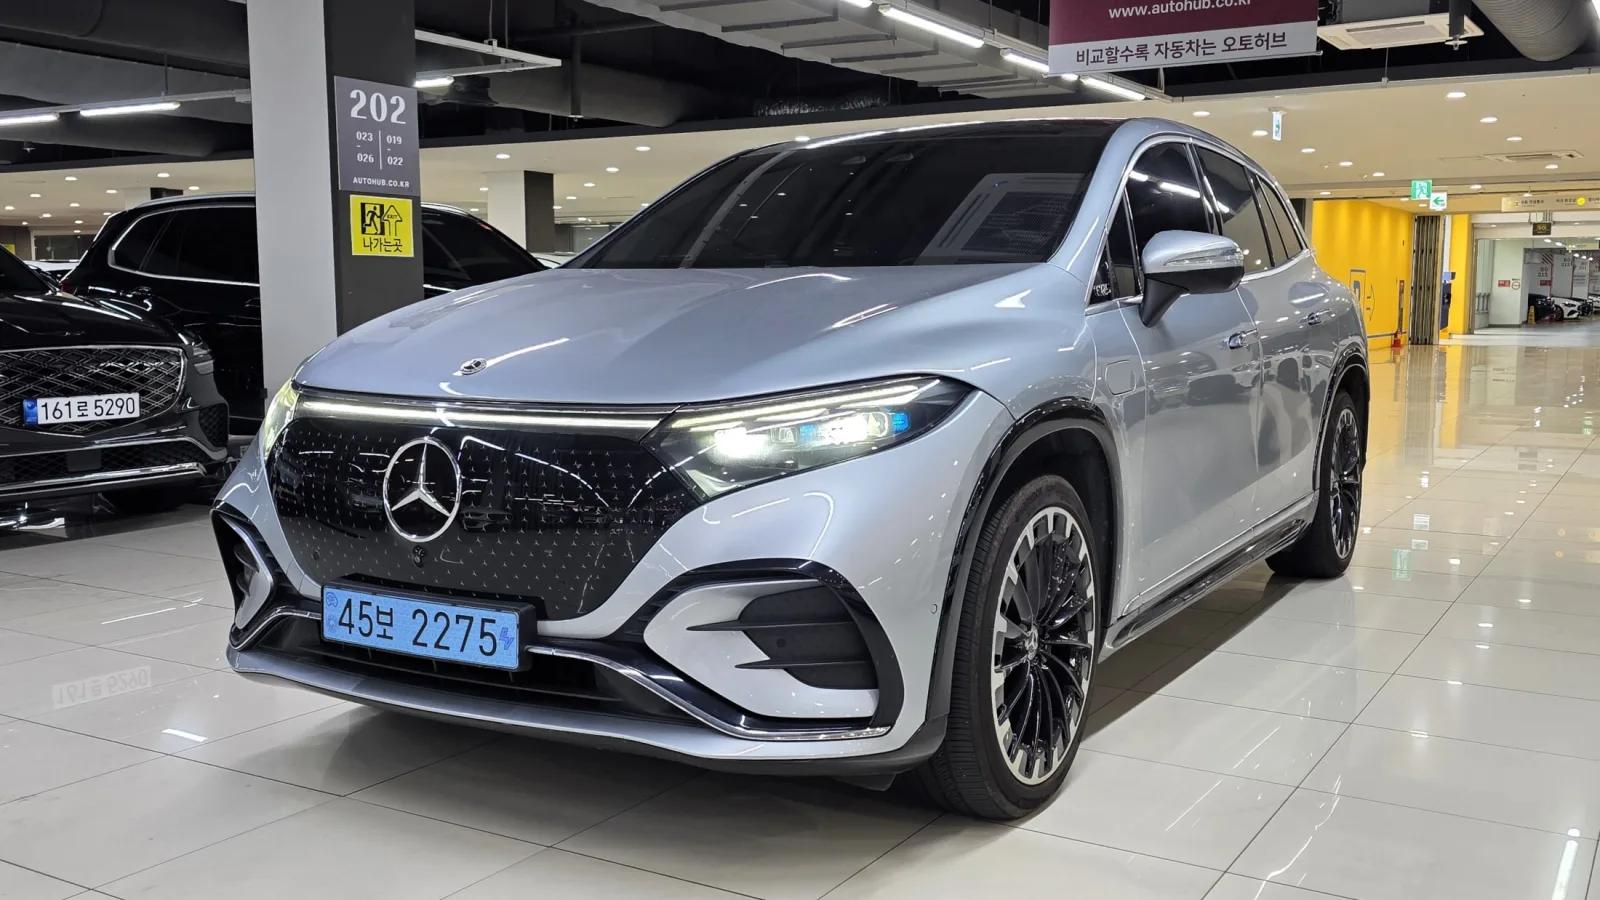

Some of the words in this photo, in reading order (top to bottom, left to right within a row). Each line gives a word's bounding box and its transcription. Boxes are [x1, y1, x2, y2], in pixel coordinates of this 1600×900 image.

[1076, 43, 1150, 66] 비교할수록
[1154, 38, 1217, 60] 자동차는
[1222, 32, 1287, 53] 오토허브
[350, 89, 406, 125] 202
[356, 131, 373, 142] 023
[386, 135, 402, 145] 019
[357, 153, 374, 163] 026
[387, 156, 403, 166] 022
[353, 176, 410, 188] AUTOHUB.CO.KR
[363, 237, 403, 253] 나가는곳
[41, 401, 89, 420] 161로
[94, 397, 135, 417] 5290
[338, 598, 393, 640] 45보
[412, 608, 498, 657] 2275
